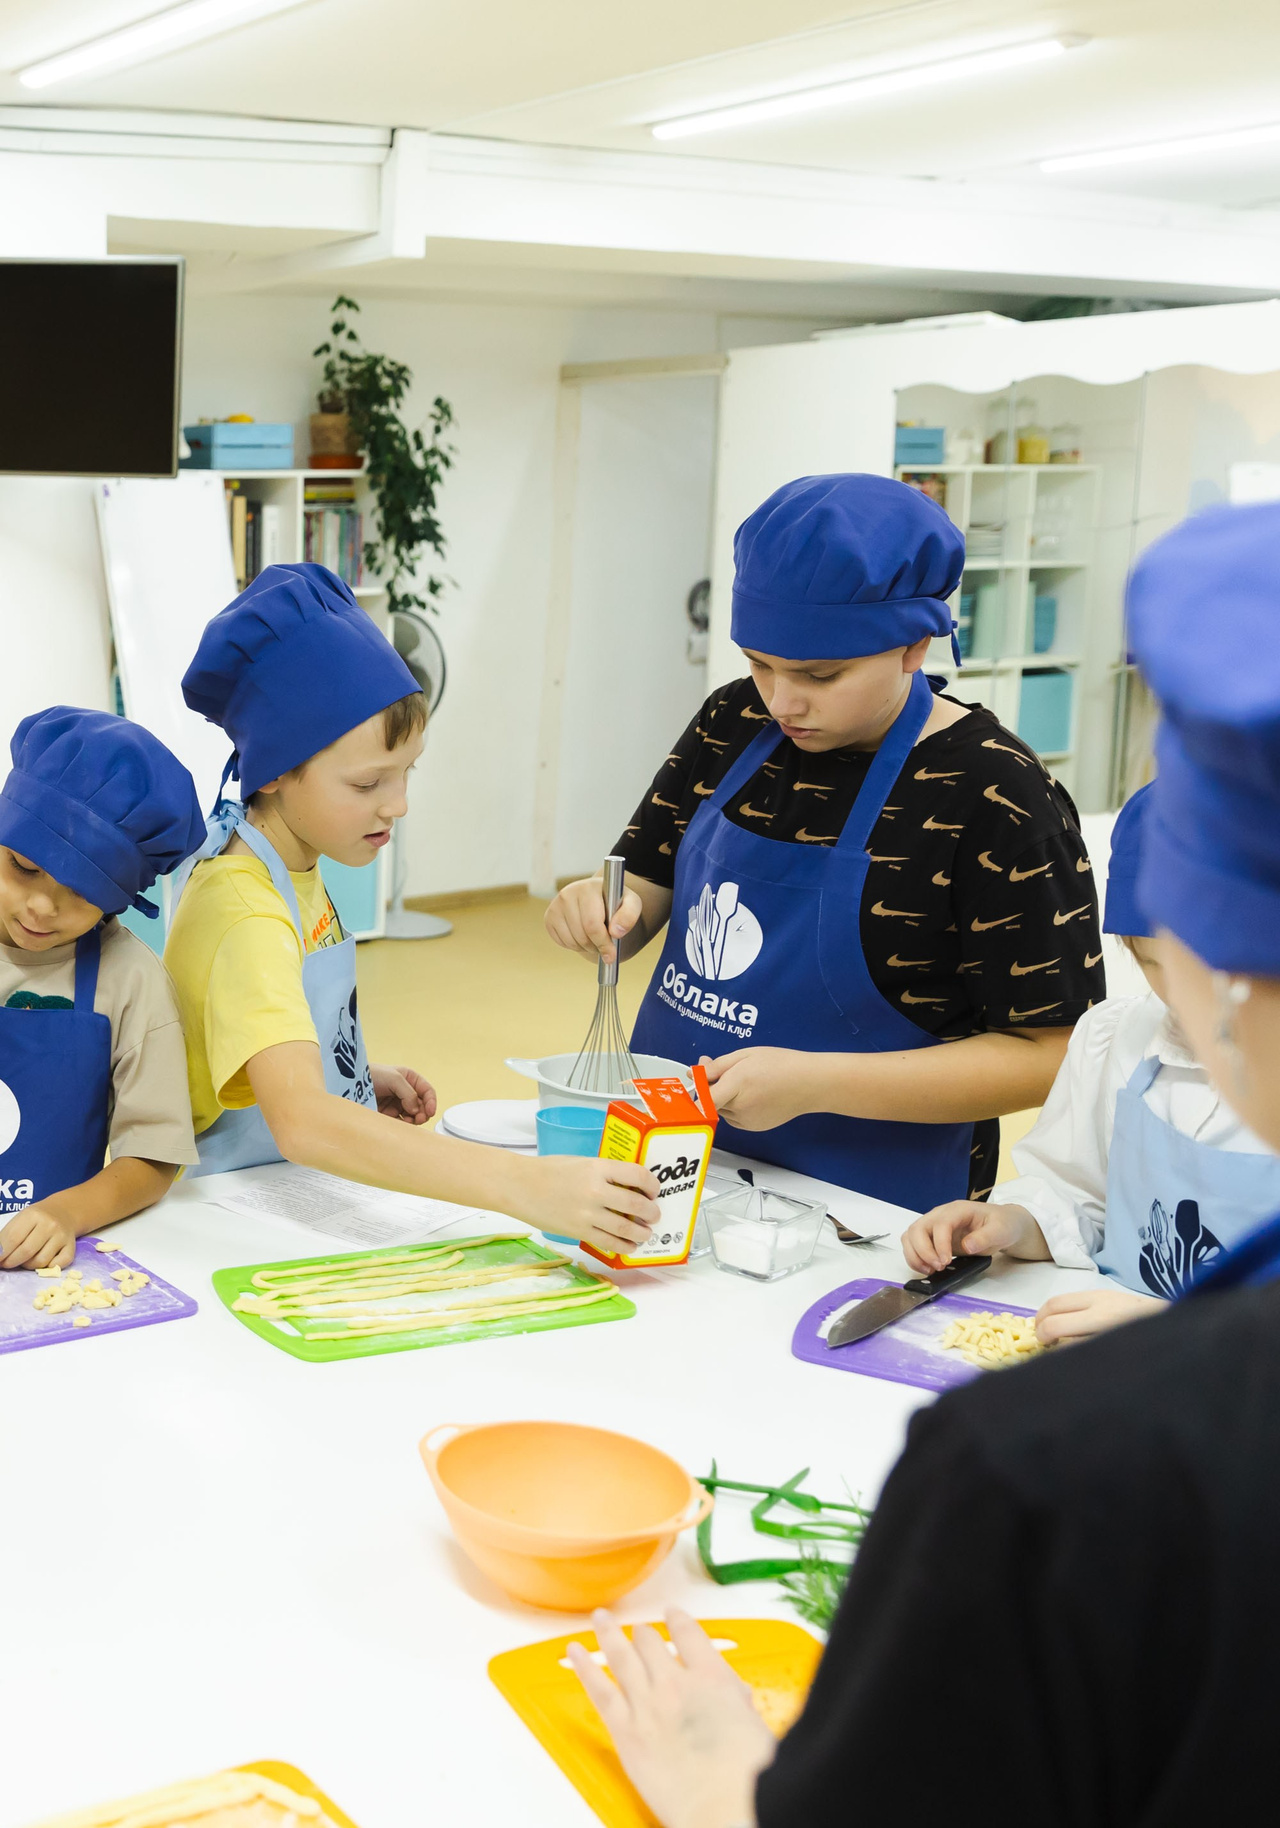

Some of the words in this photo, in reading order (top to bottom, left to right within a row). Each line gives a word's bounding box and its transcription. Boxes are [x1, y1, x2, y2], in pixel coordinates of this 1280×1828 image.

[662, 962, 759, 1027] Облака
[677, 1003, 727, 1031] кулинарный
[727, 1023, 753, 1039] клуб
[657, 1180, 696, 1198] щевая
